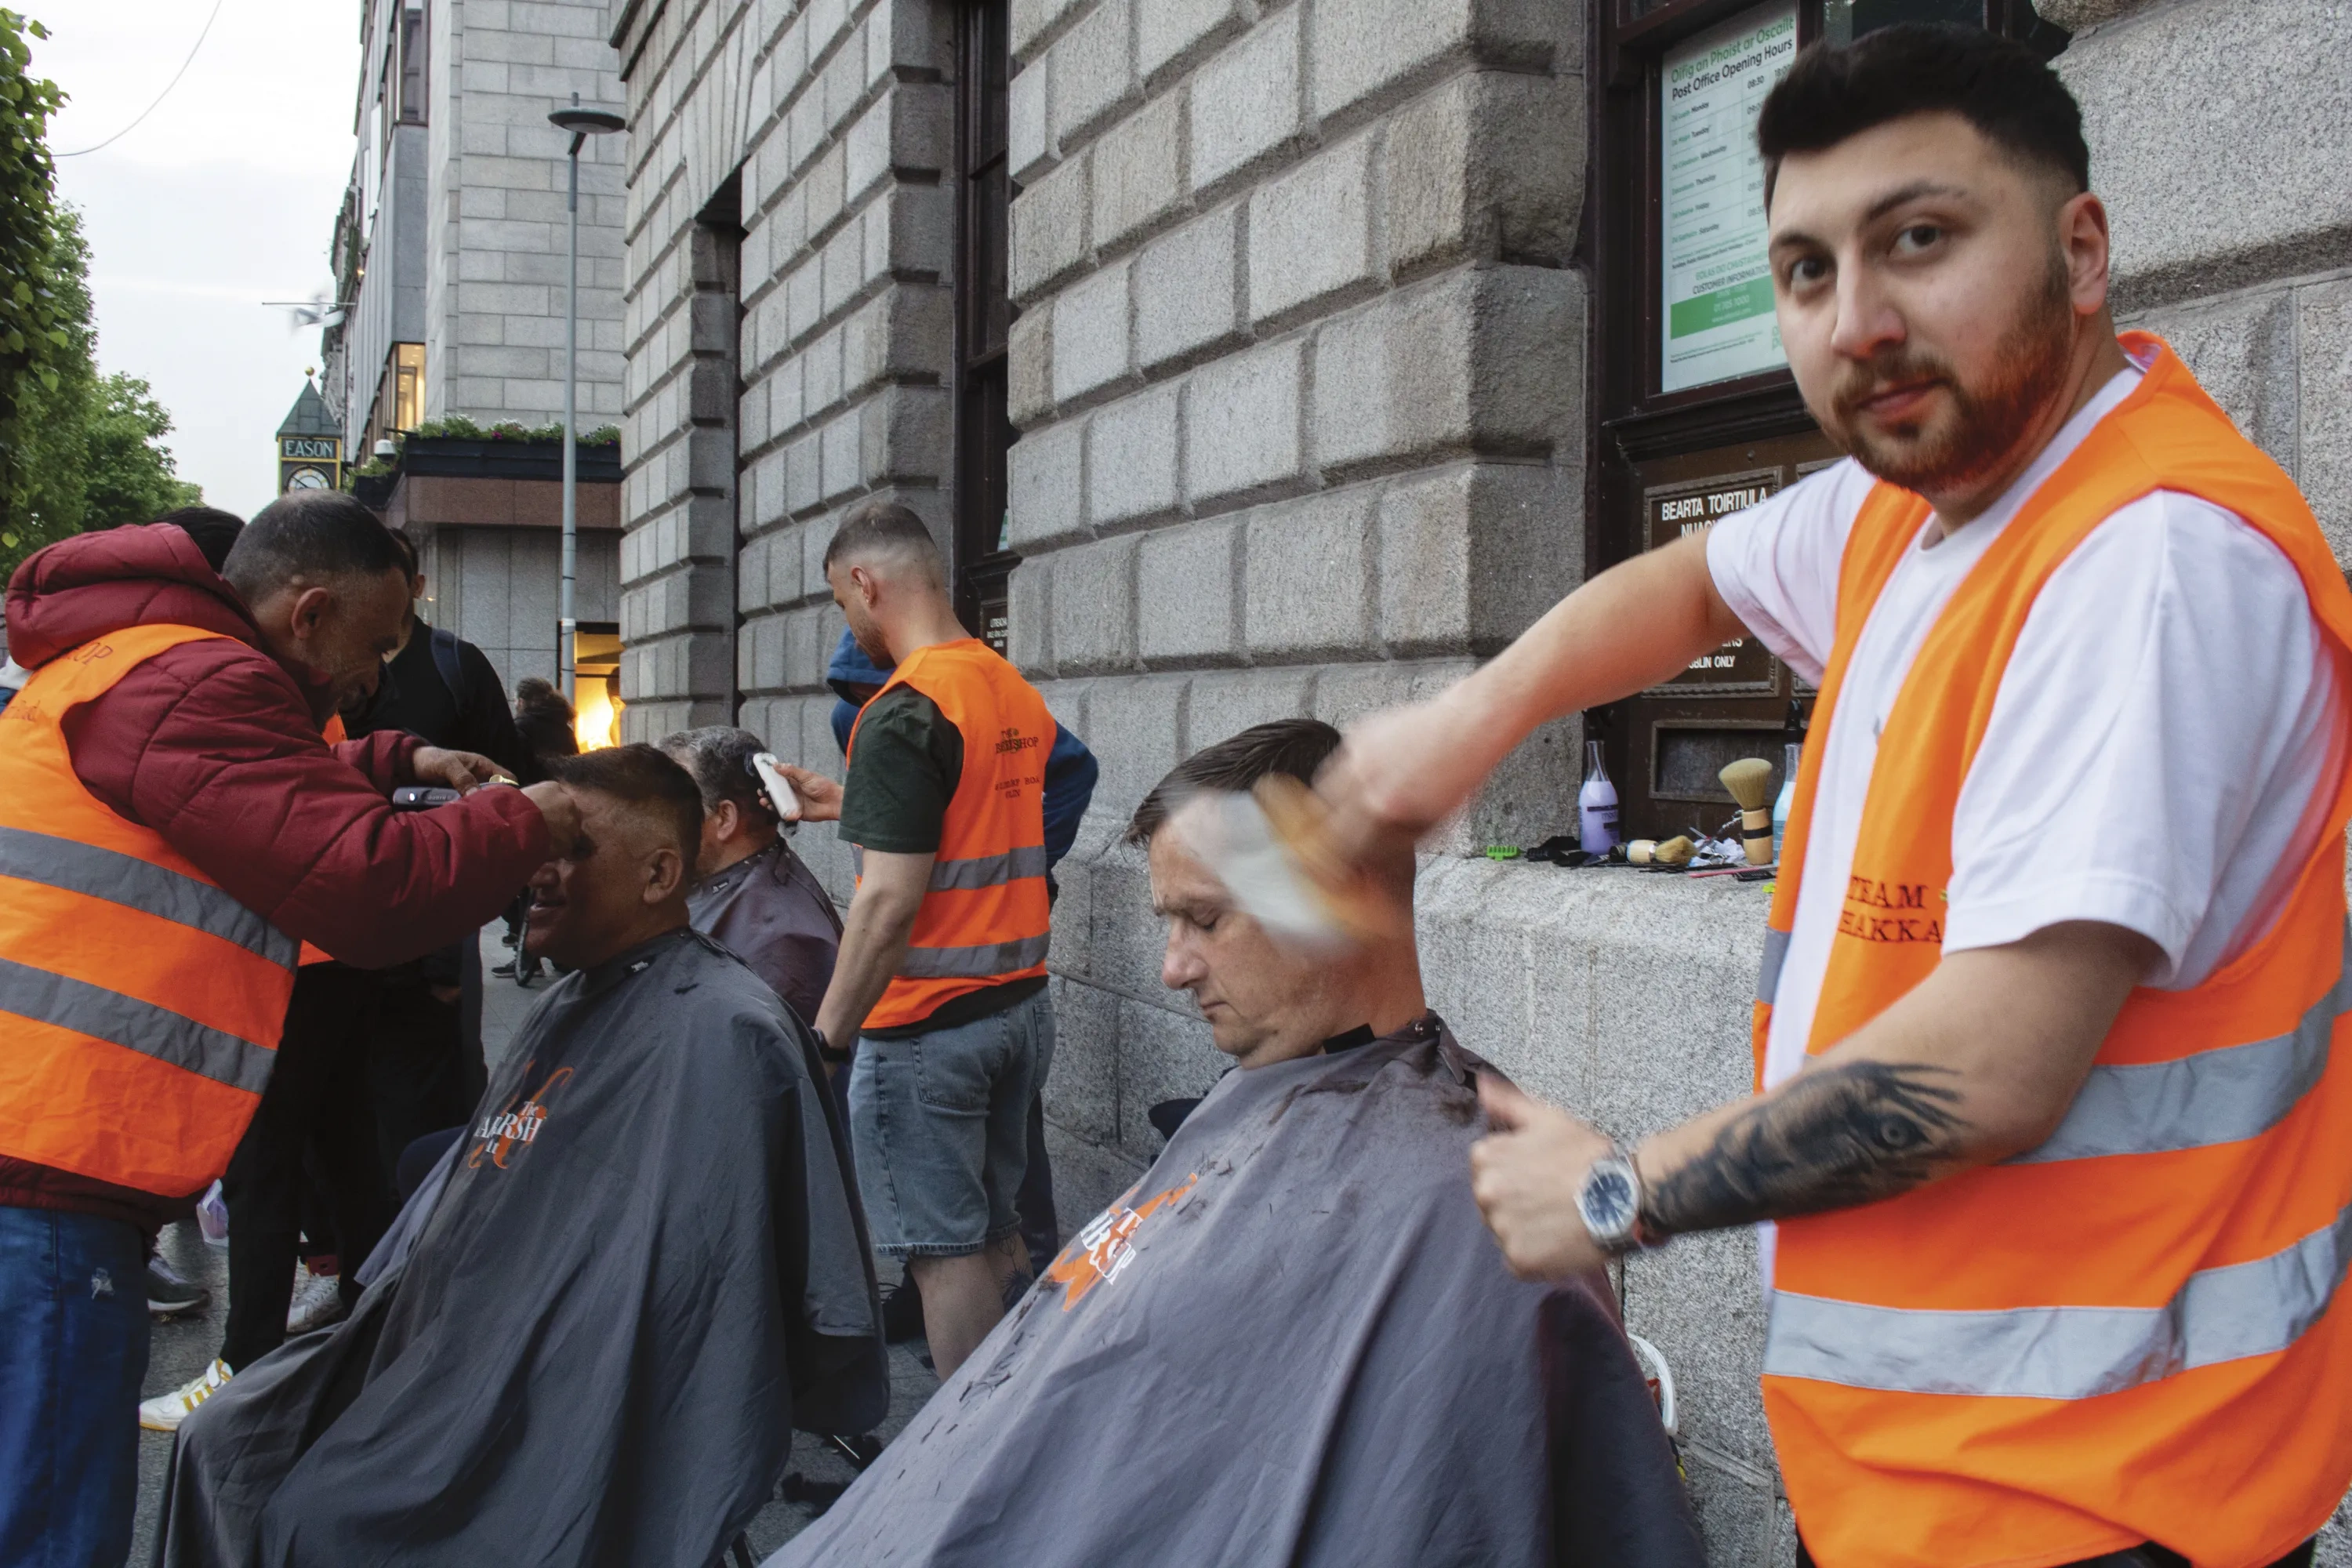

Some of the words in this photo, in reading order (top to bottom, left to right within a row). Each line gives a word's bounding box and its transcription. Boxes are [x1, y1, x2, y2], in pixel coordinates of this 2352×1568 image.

[1671, 63, 1694, 83] Oifig
[1696, 58, 1709, 71] an
[1710, 42, 1742, 66] Phoist
[1743, 38, 1755, 50] ar
[1756, 16, 1795, 45] Oscailt
[1671, 82, 1692, 101] Post
[1693, 70, 1721, 91] Office
[1722, 53, 1762, 79] Opening
[1764, 38, 1793, 60] Hours
[285, 440, 333, 457] EASON
[1661, 497, 1704, 521] BEARTA
[1688, 655, 1712, 669] UBLIN
[1714, 655, 1736, 668] ONLY
